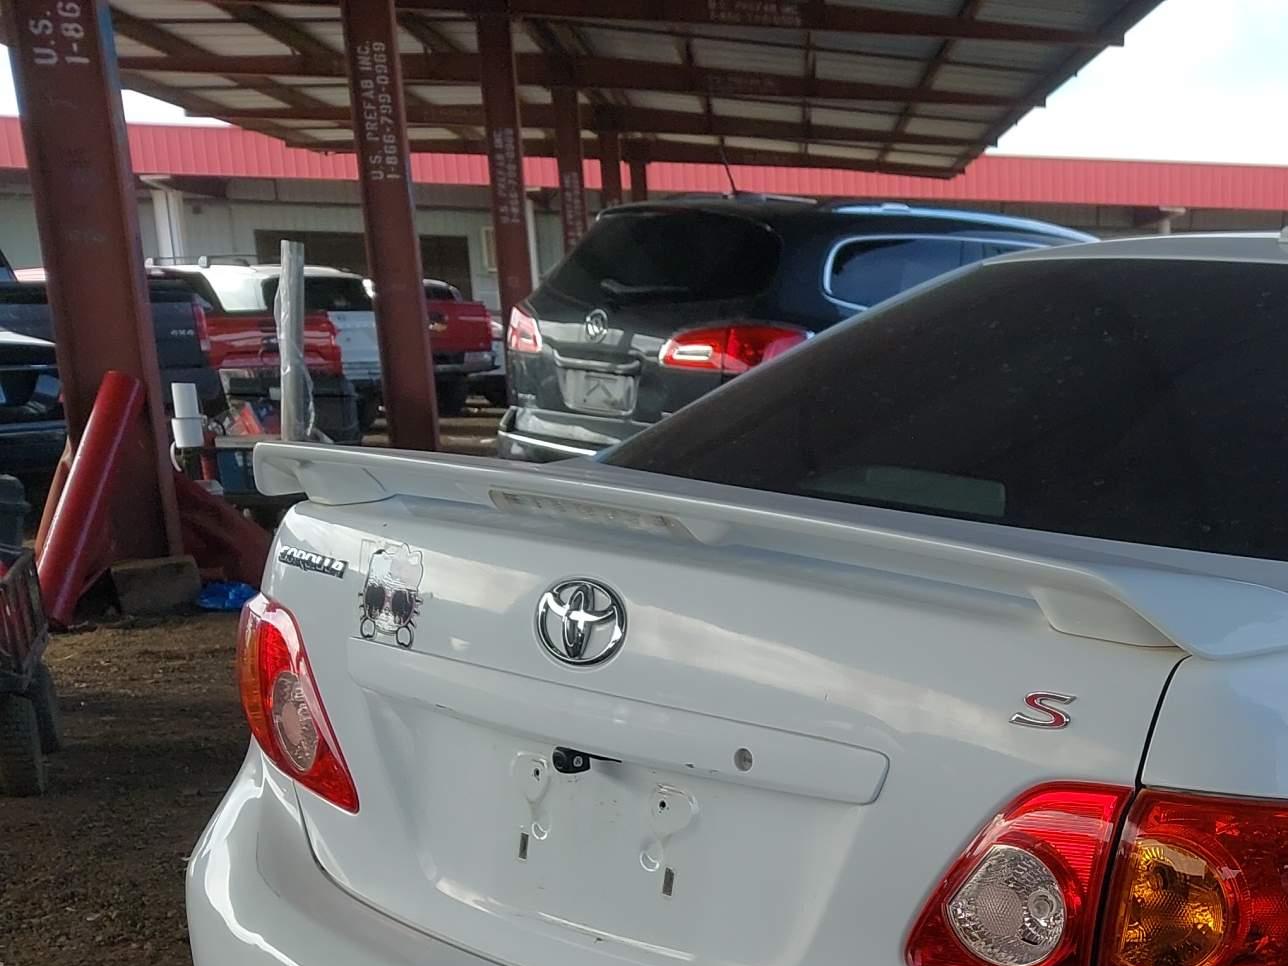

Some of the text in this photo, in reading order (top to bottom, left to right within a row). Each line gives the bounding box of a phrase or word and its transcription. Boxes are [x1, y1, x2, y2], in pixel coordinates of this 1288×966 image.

[29, 10, 59, 64] U.S.
[360, 79, 380, 141] PREFAB
[369, 151, 385, 180] U.S.
[1008, 690, 1077, 730] S
